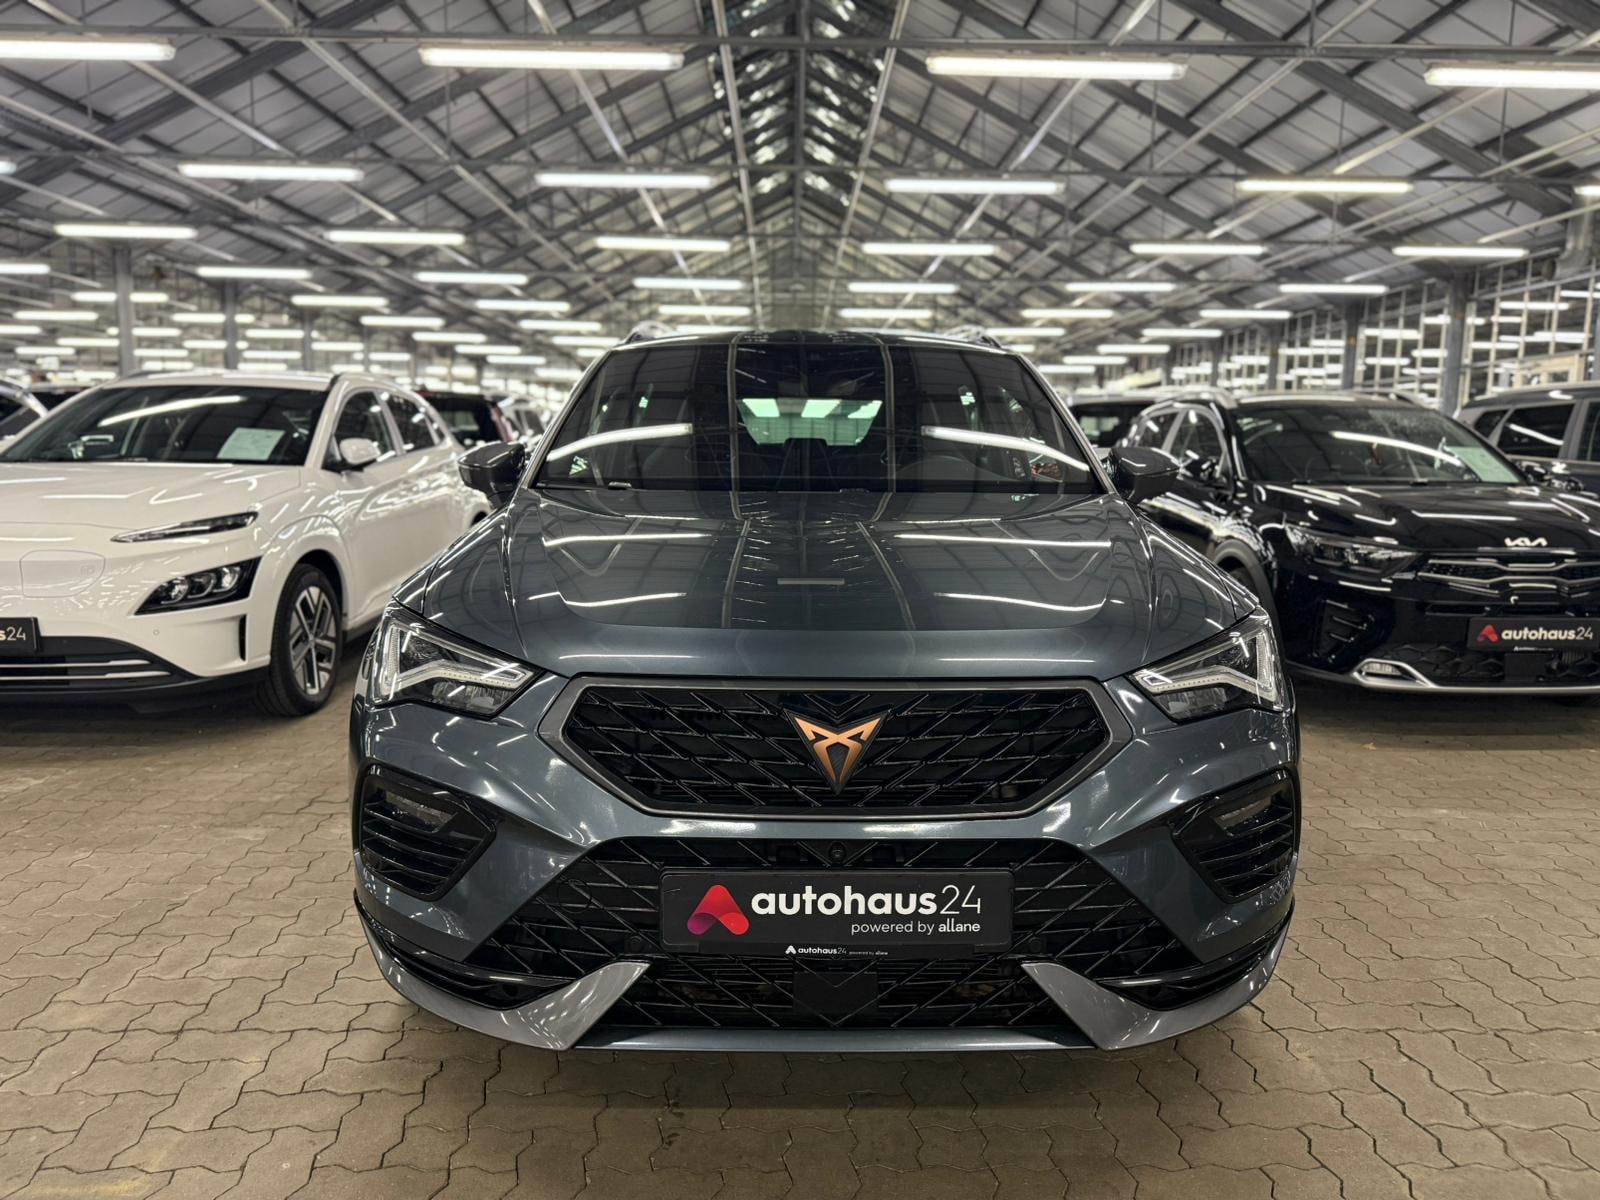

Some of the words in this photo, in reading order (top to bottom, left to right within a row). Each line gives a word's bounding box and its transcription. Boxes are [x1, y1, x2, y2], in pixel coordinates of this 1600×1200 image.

[1501, 626, 1594, 640] autohaus24
[751, 885, 981, 916] autohaus24
[851, 920, 914, 935] powered
[917, 920, 935, 935] by
[938, 918, 981, 932] allane
[797, 946, 847, 955] autohaus24
